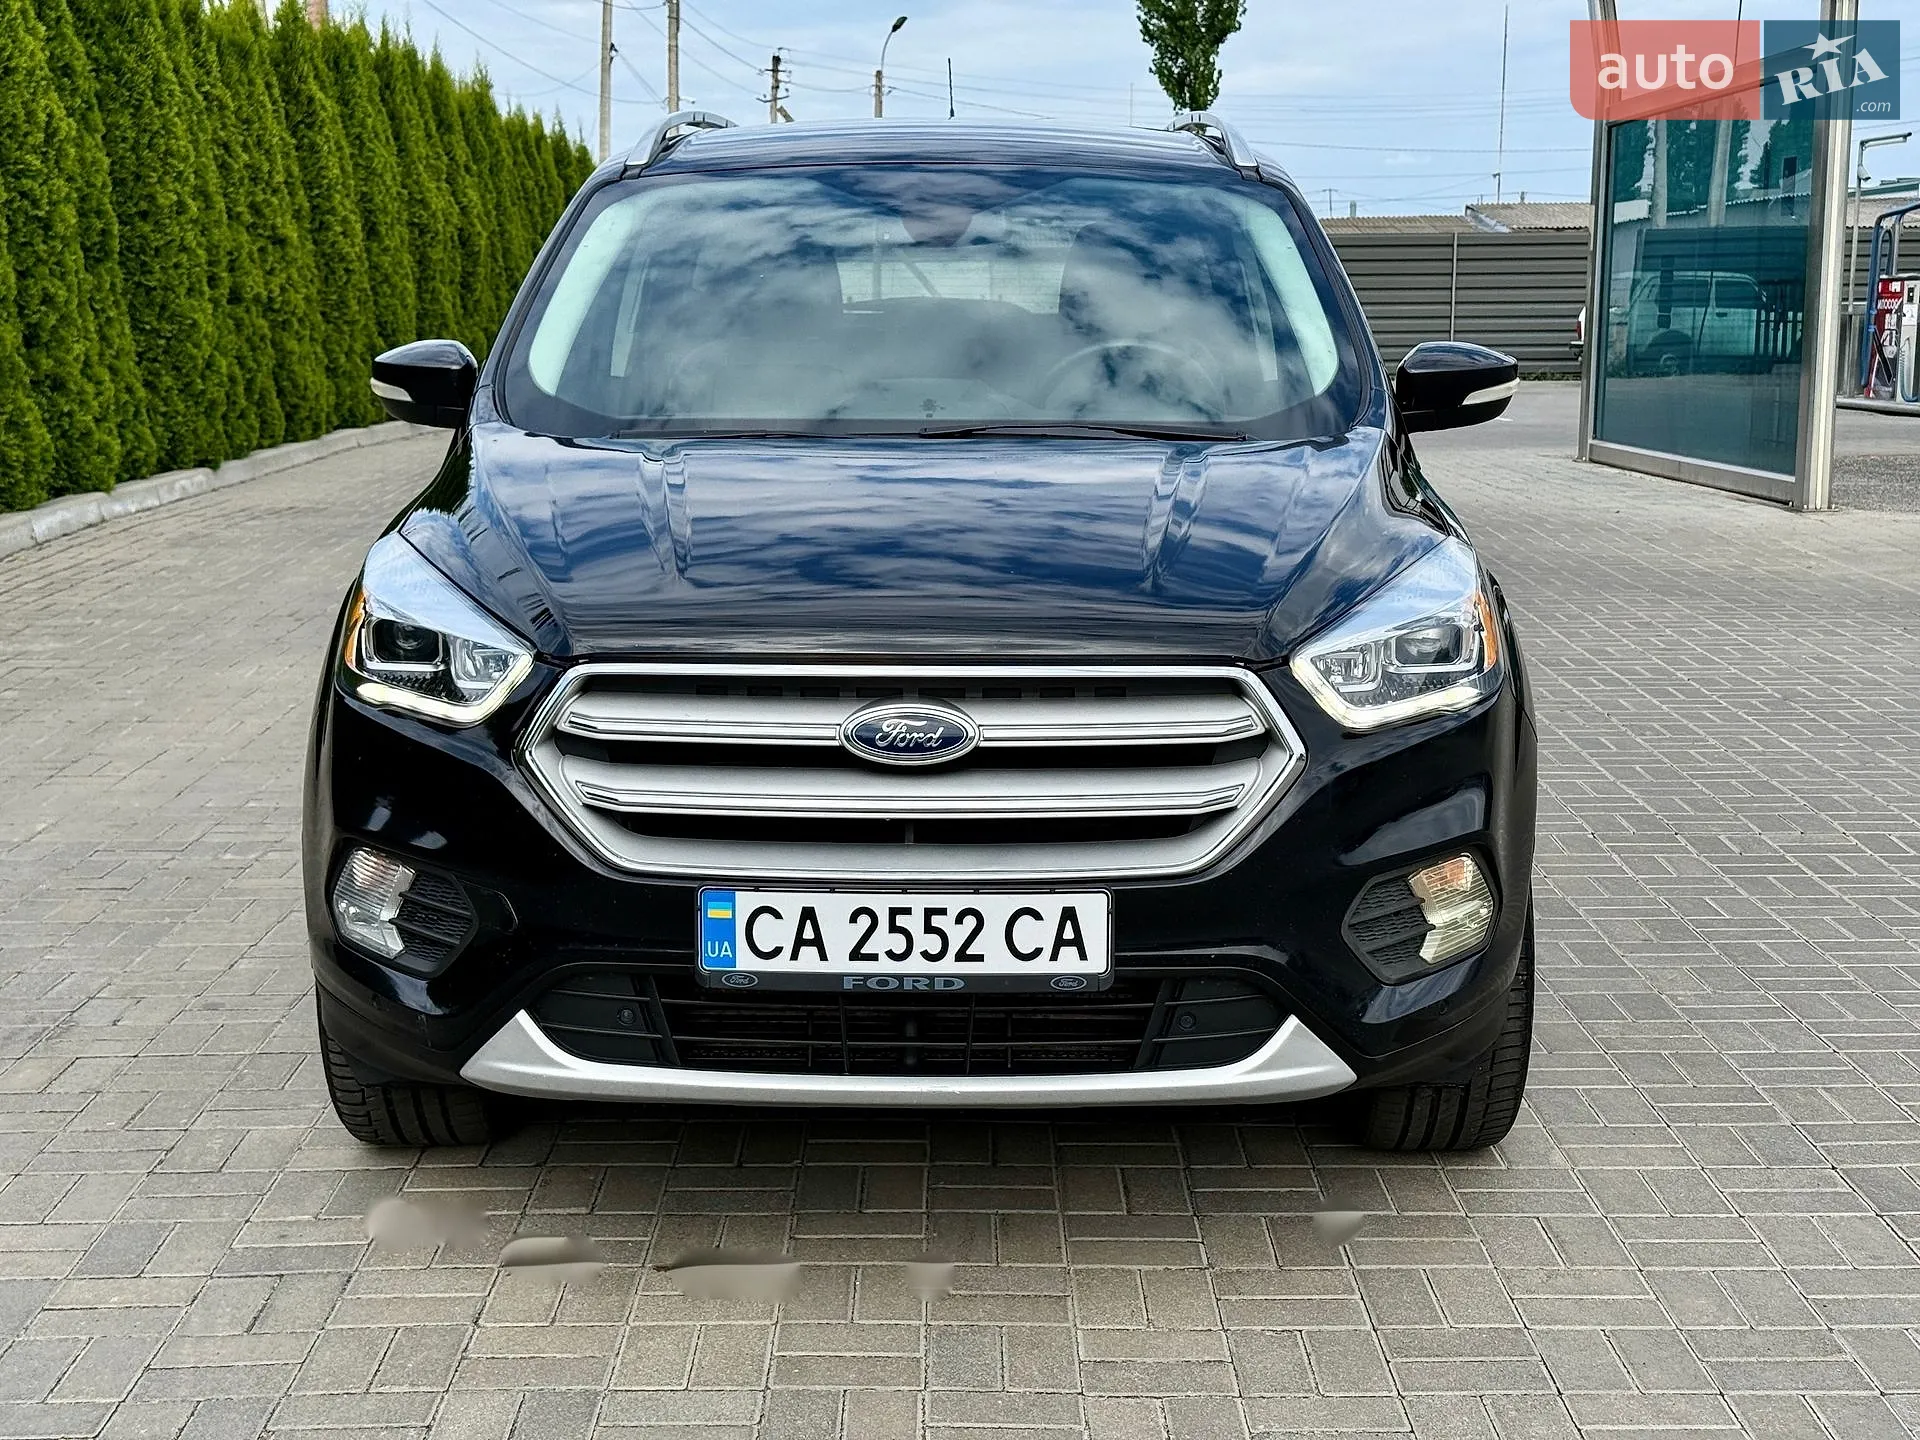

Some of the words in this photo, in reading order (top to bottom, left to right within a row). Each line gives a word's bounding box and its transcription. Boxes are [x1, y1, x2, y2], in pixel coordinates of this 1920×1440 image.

[875, 718, 945, 748] Ford
[745, 905, 829, 961] CA
[848, 906, 985, 963] 2552
[1004, 906, 1089, 961] CA
[707, 941, 733, 958] UA
[843, 976, 965, 990] FORD
